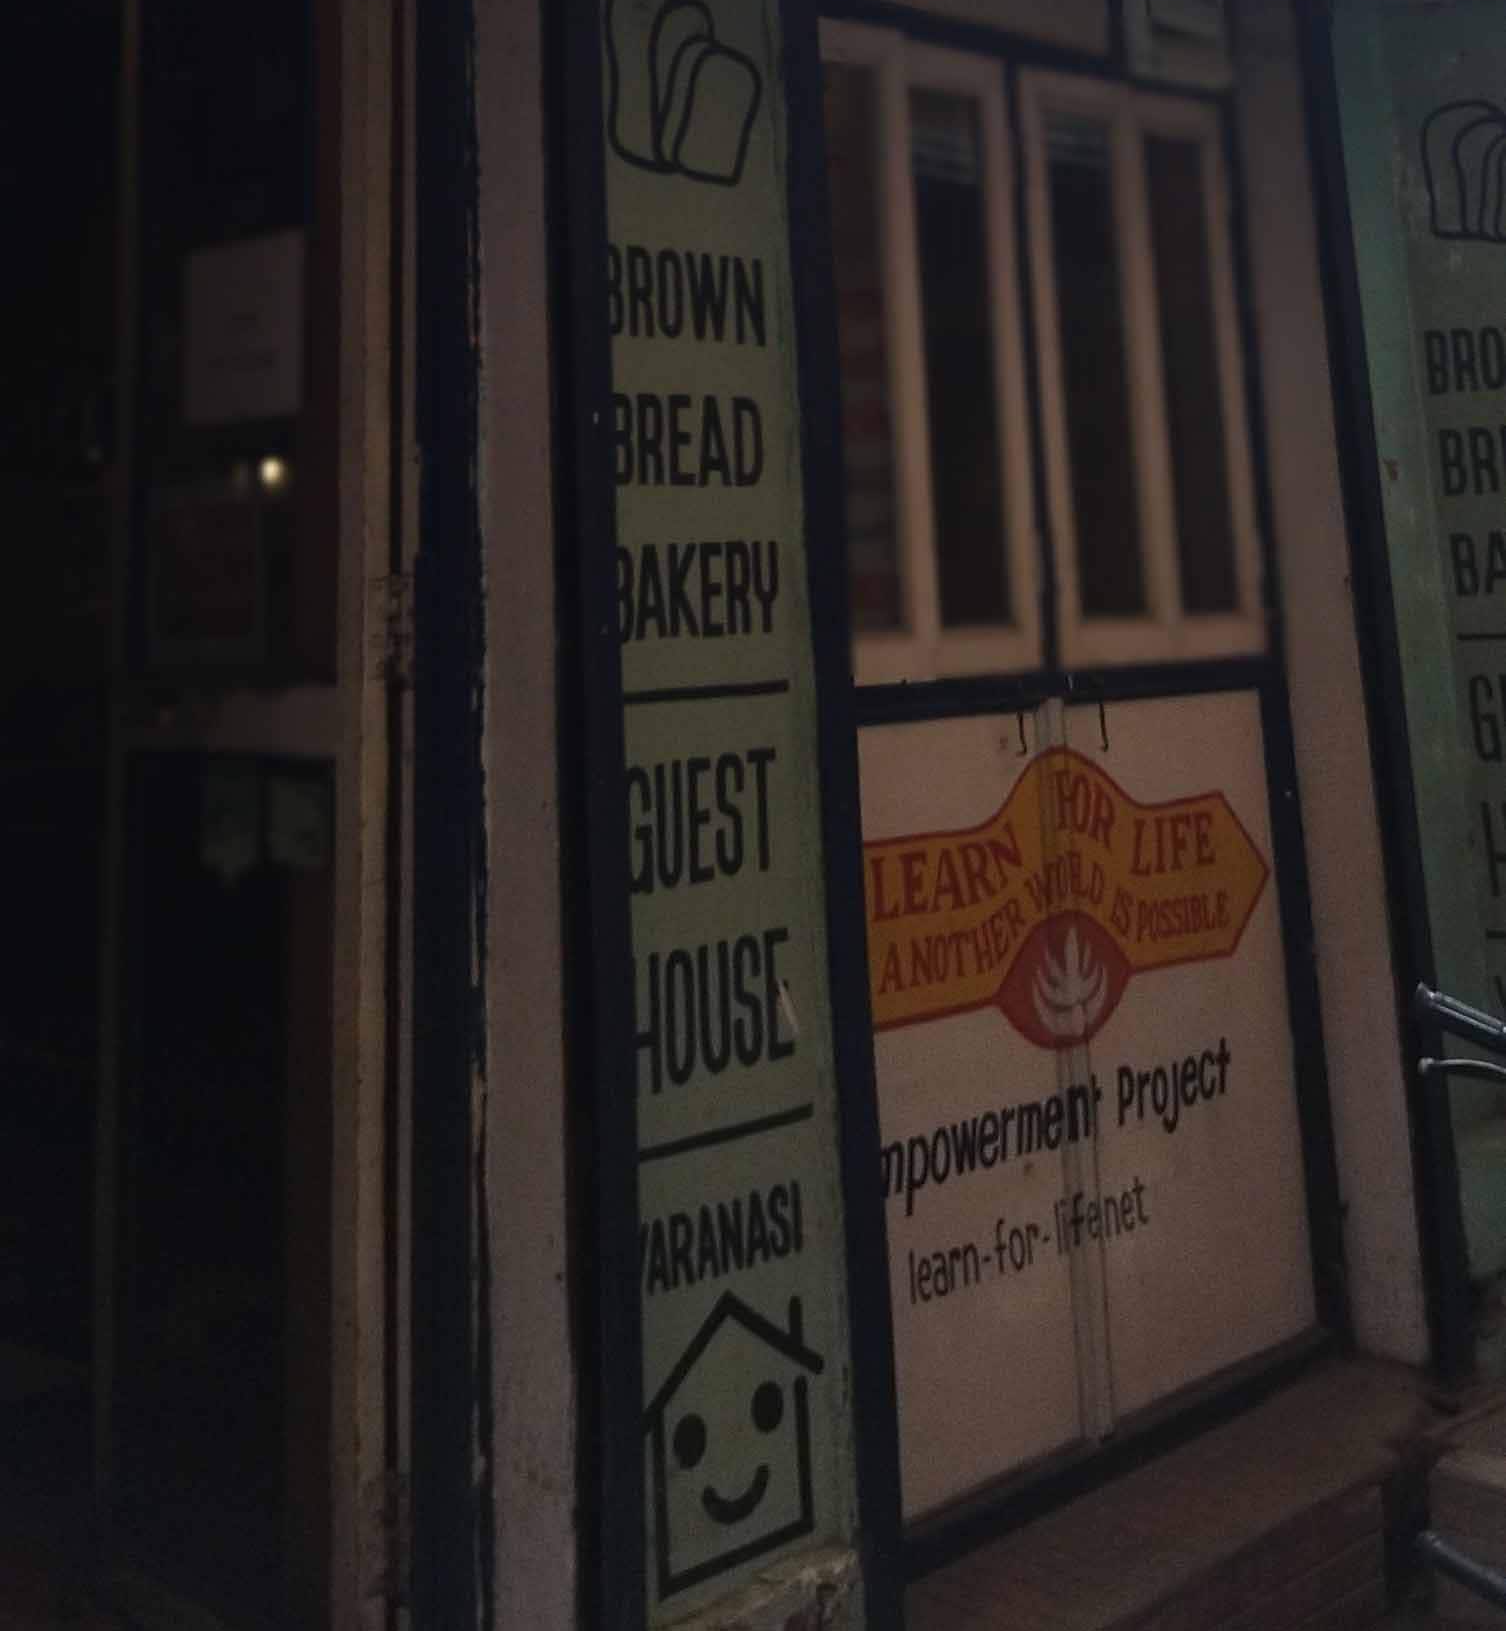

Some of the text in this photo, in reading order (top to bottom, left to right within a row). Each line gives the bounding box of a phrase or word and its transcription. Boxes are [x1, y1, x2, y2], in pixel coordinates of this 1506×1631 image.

[606, 243, 766, 347] BROWN
[612, 392, 764, 488] BREAD
[1438, 424, 1506, 497] BR
[615, 540, 780, 644] BAKERY
[628, 747, 776, 895] GUEST
[870, 769, 1216, 924] LEARN FOR LIFE
[878, 898, 1028, 996] ANOTHER
[1110, 885, 1135, 939] IS
[1136, 889, 1231, 942] POSSIBLE
